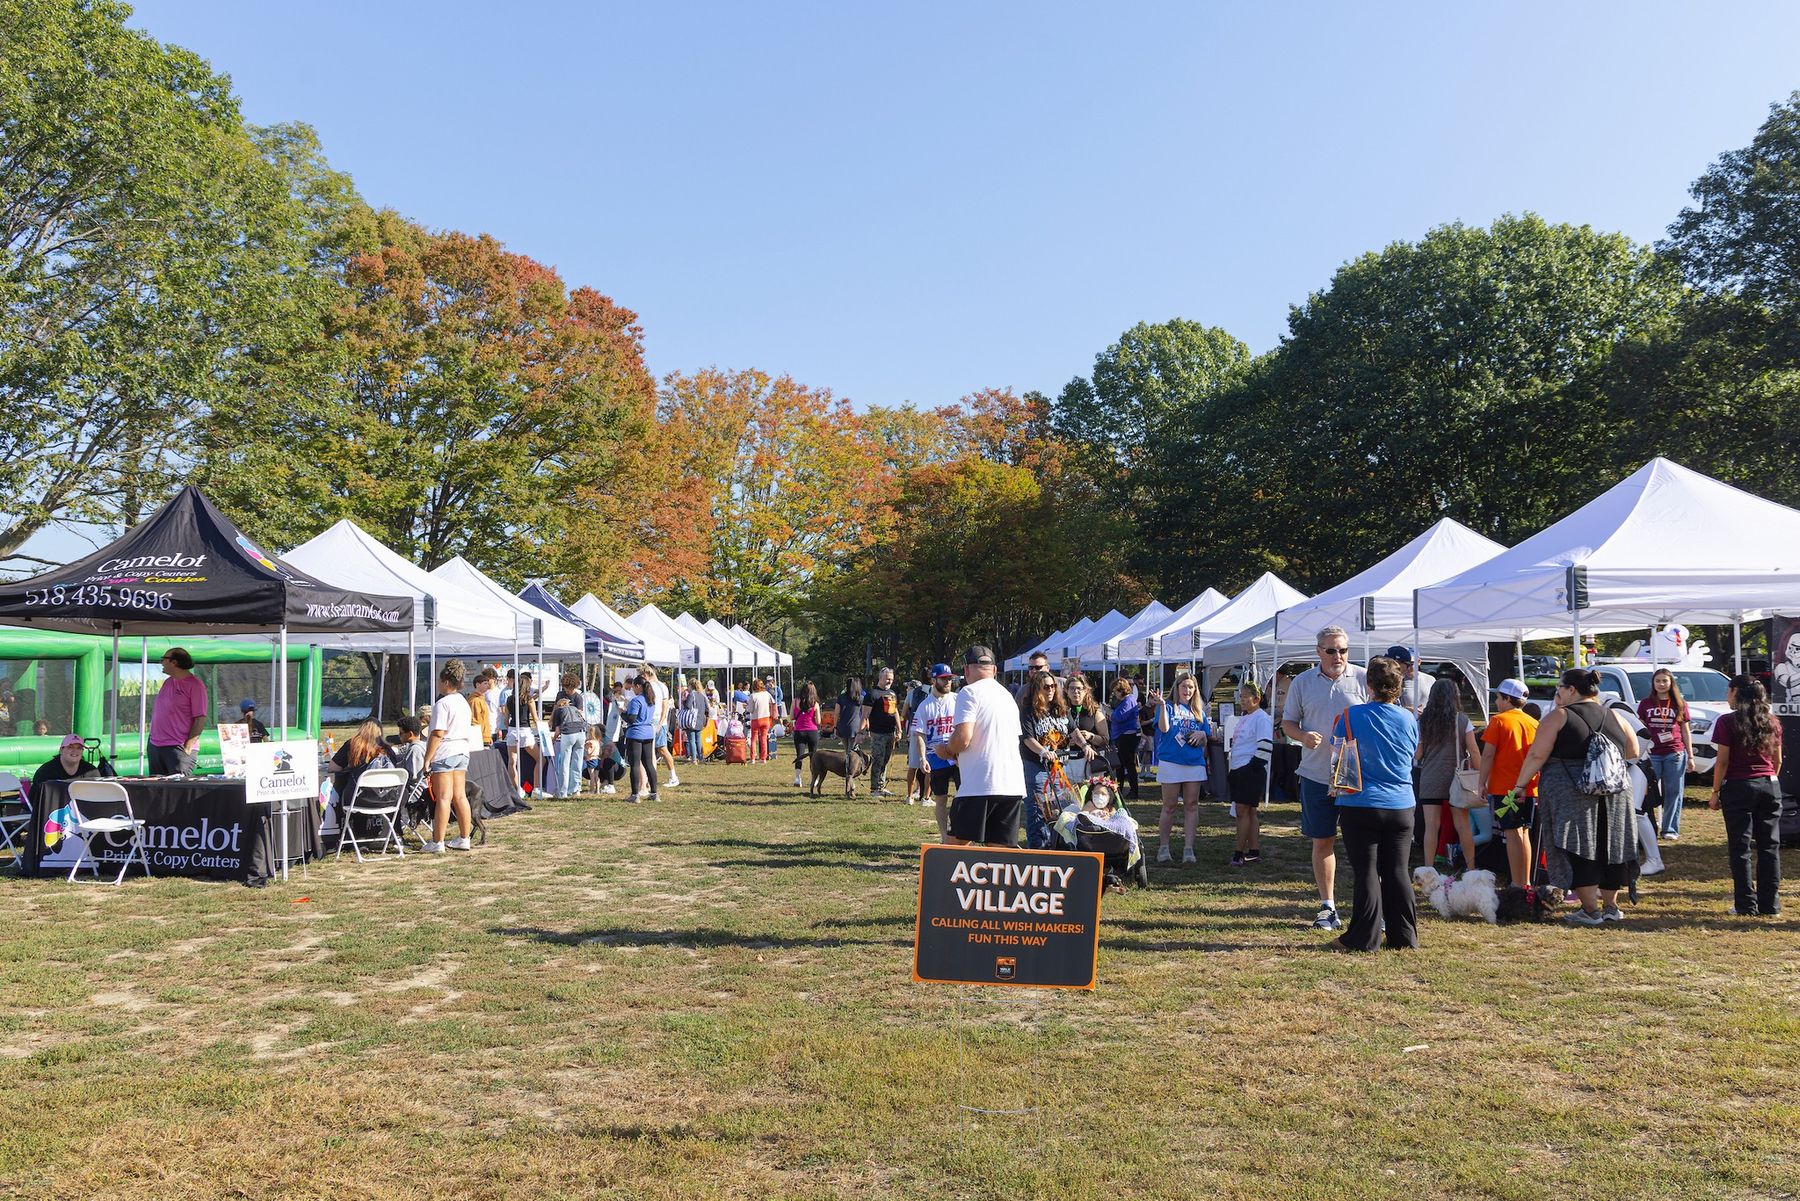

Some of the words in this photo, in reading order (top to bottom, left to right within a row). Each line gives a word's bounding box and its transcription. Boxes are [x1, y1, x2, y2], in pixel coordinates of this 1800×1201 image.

[97, 553, 207, 573] Camelot
[124, 571, 154, 579] Copy
[25, 584, 173, 611] 518.435.9696
[260, 775, 306, 789] Camelot
[104, 814, 243, 852] Camelot
[103, 849, 137, 864] Print
[153, 851, 190, 869] Copy
[191, 852, 240, 869] Centers
[950, 861, 1075, 888] ACTIVITY
[956, 888, 1065, 916] VILLAGE
[931, 917, 979, 929] CALLING
[981, 920, 1000, 931] ALL
[1002, 921, 1033, 932] WISH
[1035, 923, 1084, 934] MAKERS!
[968, 933, 991, 944] FUN
[994, 935, 1019, 945] THIS
[1021, 936, 1047, 946] WAY
